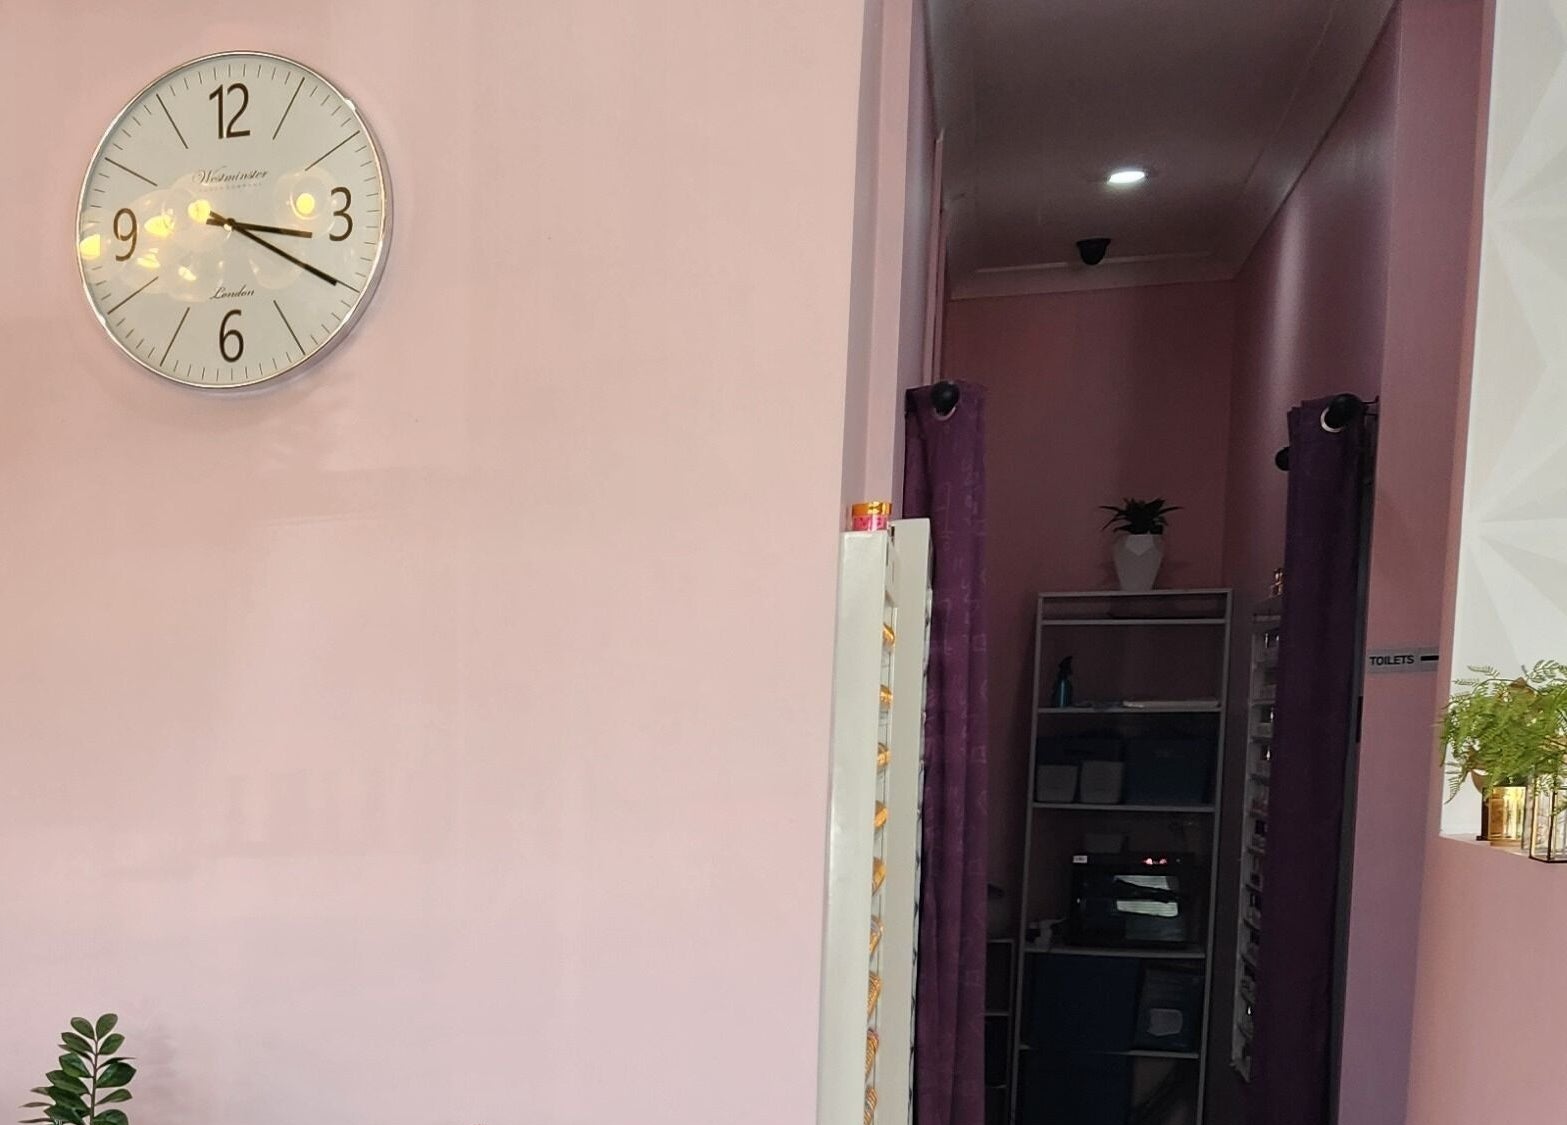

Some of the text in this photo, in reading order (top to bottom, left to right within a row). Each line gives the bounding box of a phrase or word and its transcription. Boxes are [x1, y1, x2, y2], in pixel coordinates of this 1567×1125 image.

[209, 82, 251, 140] 12
[193, 165, 268, 184] Westminster
[113, 208, 138, 262] 9
[329, 186, 353, 242] 3
[209, 284, 255, 300] London
[218, 309, 244, 363] 6
[1369, 655, 1415, 666] TOILETS
